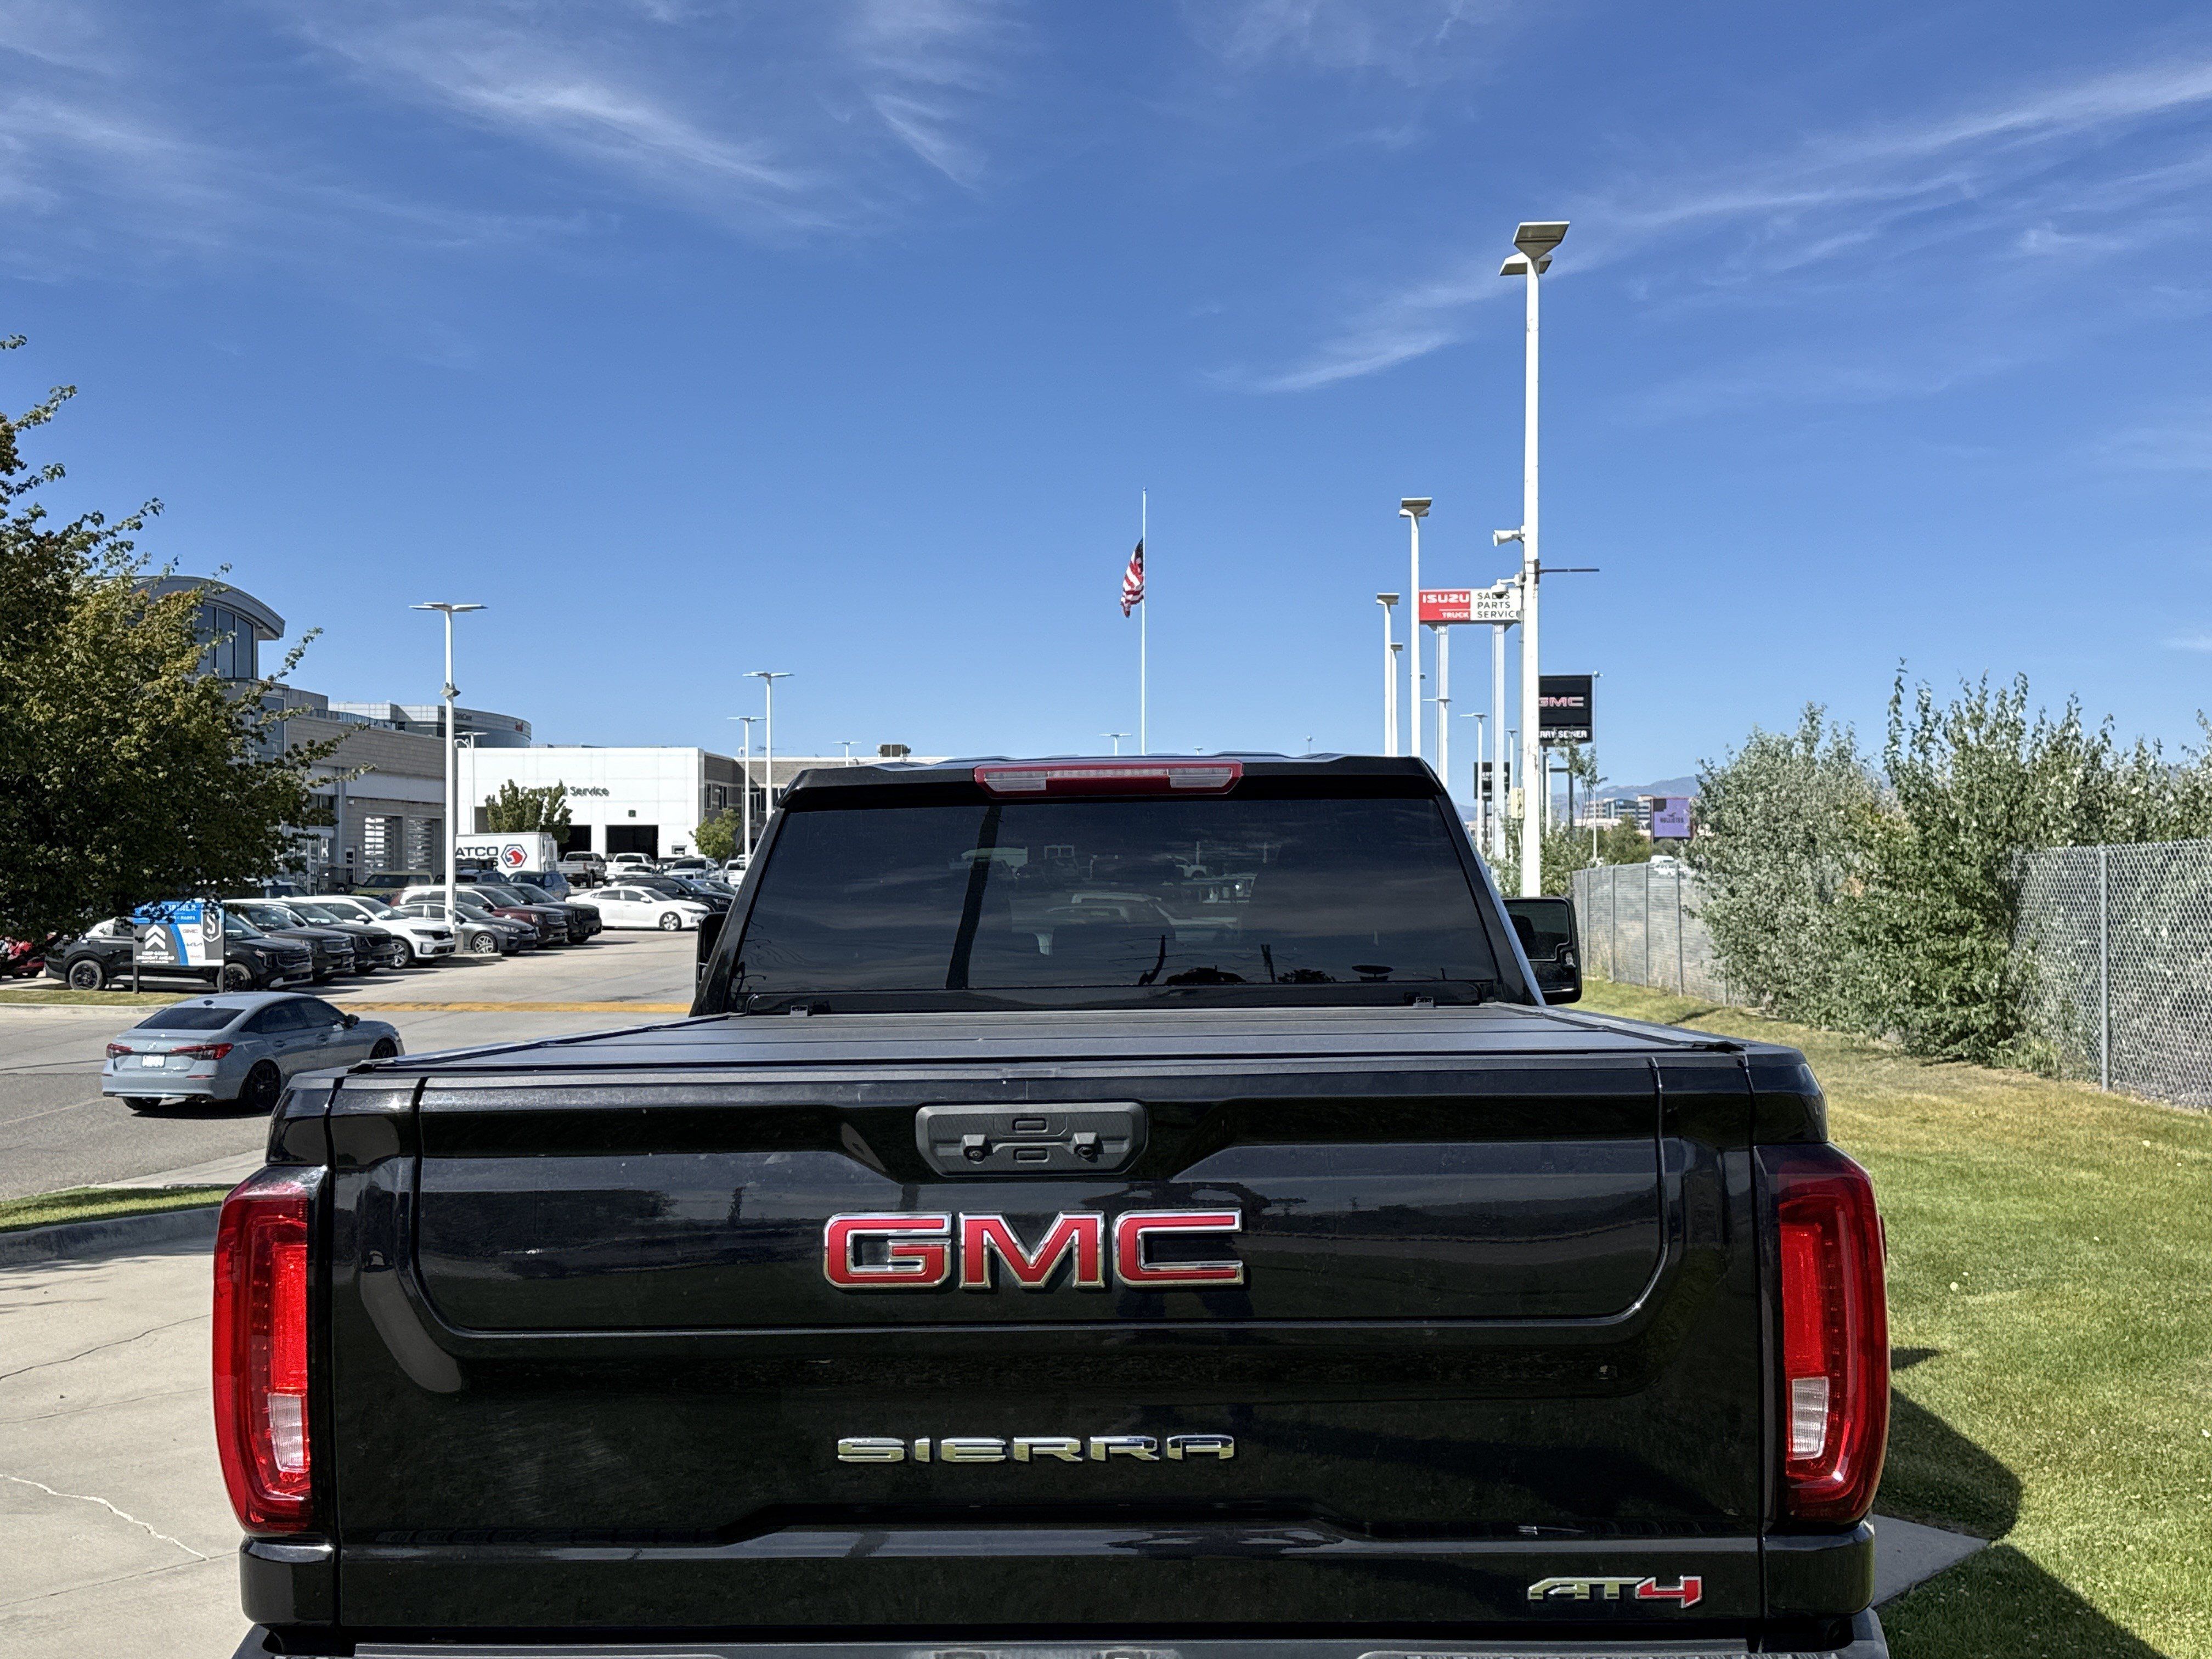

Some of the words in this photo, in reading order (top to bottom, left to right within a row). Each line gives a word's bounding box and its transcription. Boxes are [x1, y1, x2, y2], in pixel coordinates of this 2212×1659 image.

[1423, 594, 1470, 603] ISUZU
[1477, 610, 1519, 618] SERVIC
[569, 786, 610, 797] Service
[455, 846, 499, 857] ATCO
[823, 1209, 1244, 1289] GMC
[837, 1435, 1235, 1463] SIERRA
[1527, 1575, 1702, 1609] AT4
